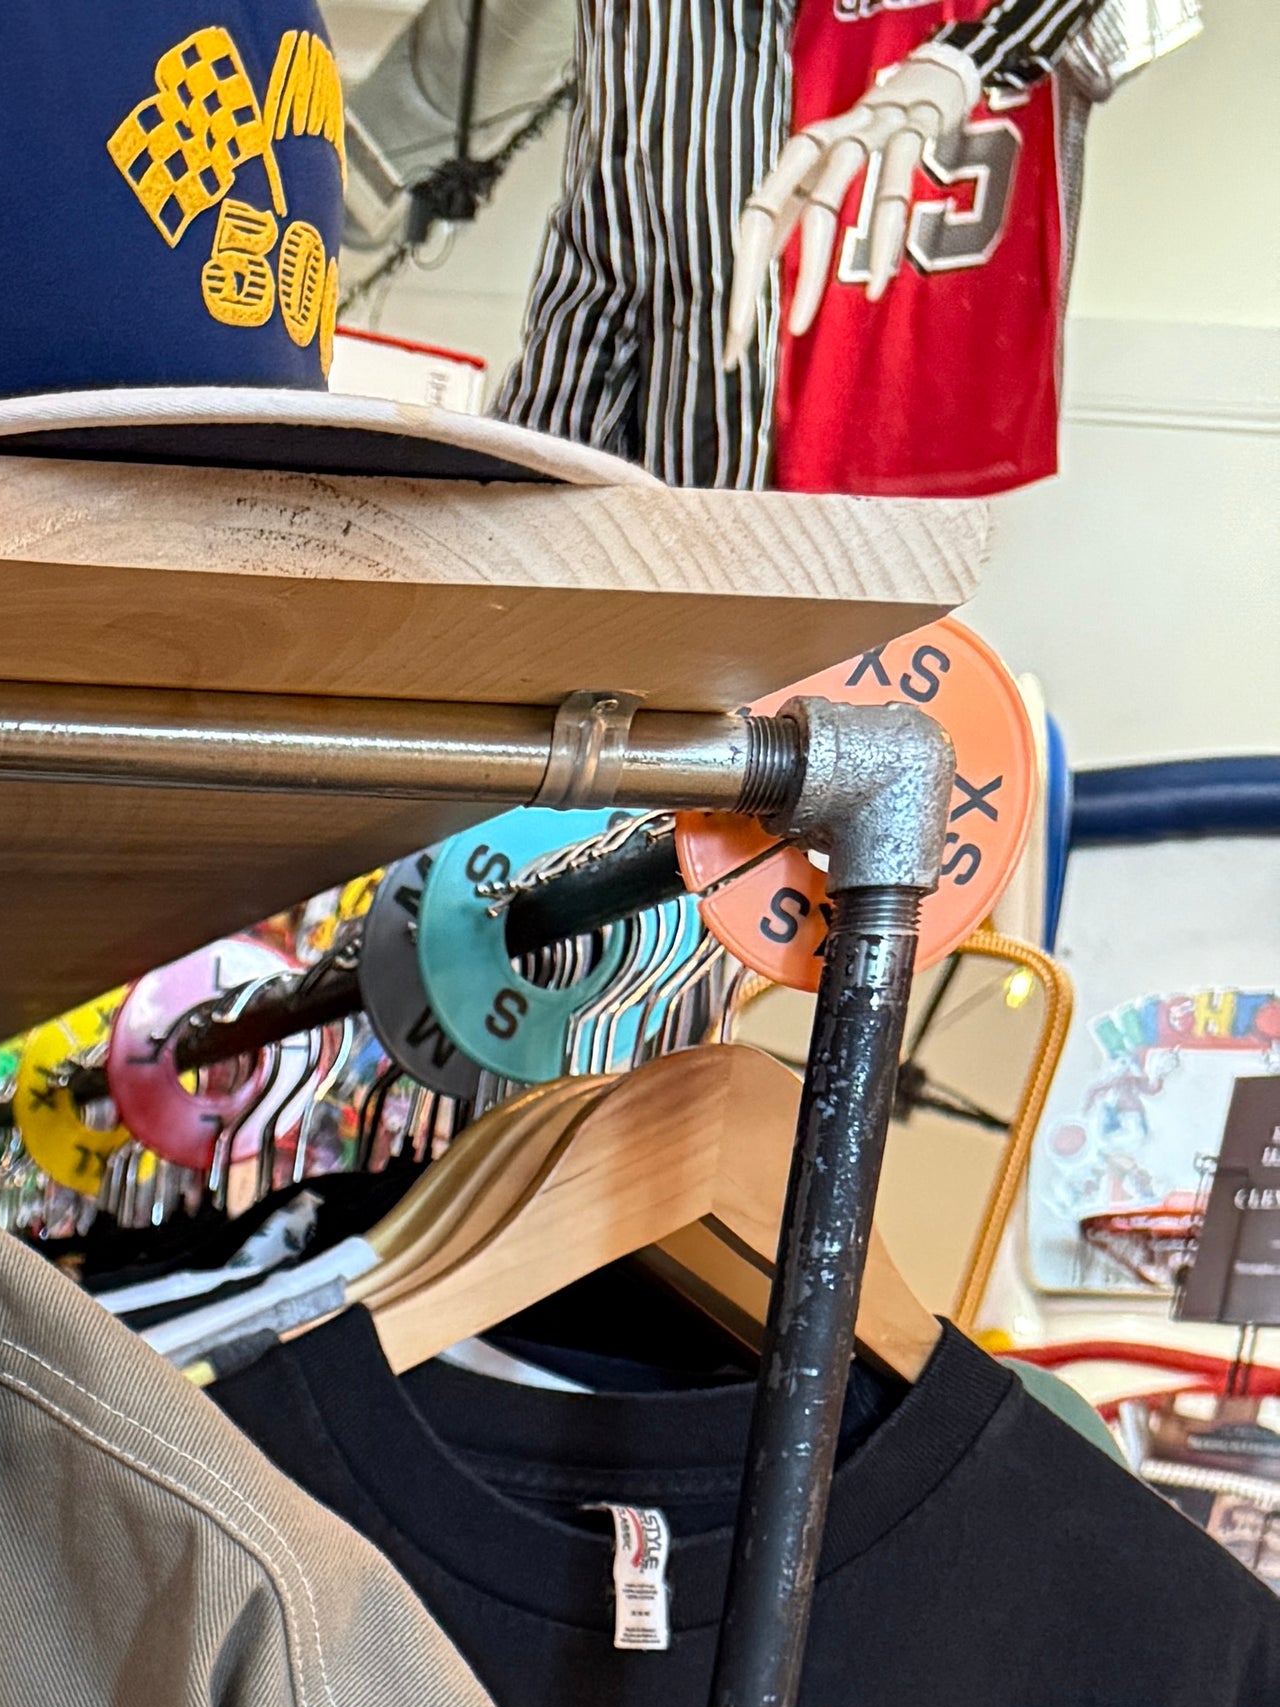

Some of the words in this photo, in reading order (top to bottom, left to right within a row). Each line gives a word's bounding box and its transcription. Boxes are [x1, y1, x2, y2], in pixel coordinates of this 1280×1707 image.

[845, 643, 952, 703] XS
[940, 773, 1004, 886] XS
[485, 988, 529, 1040] S
